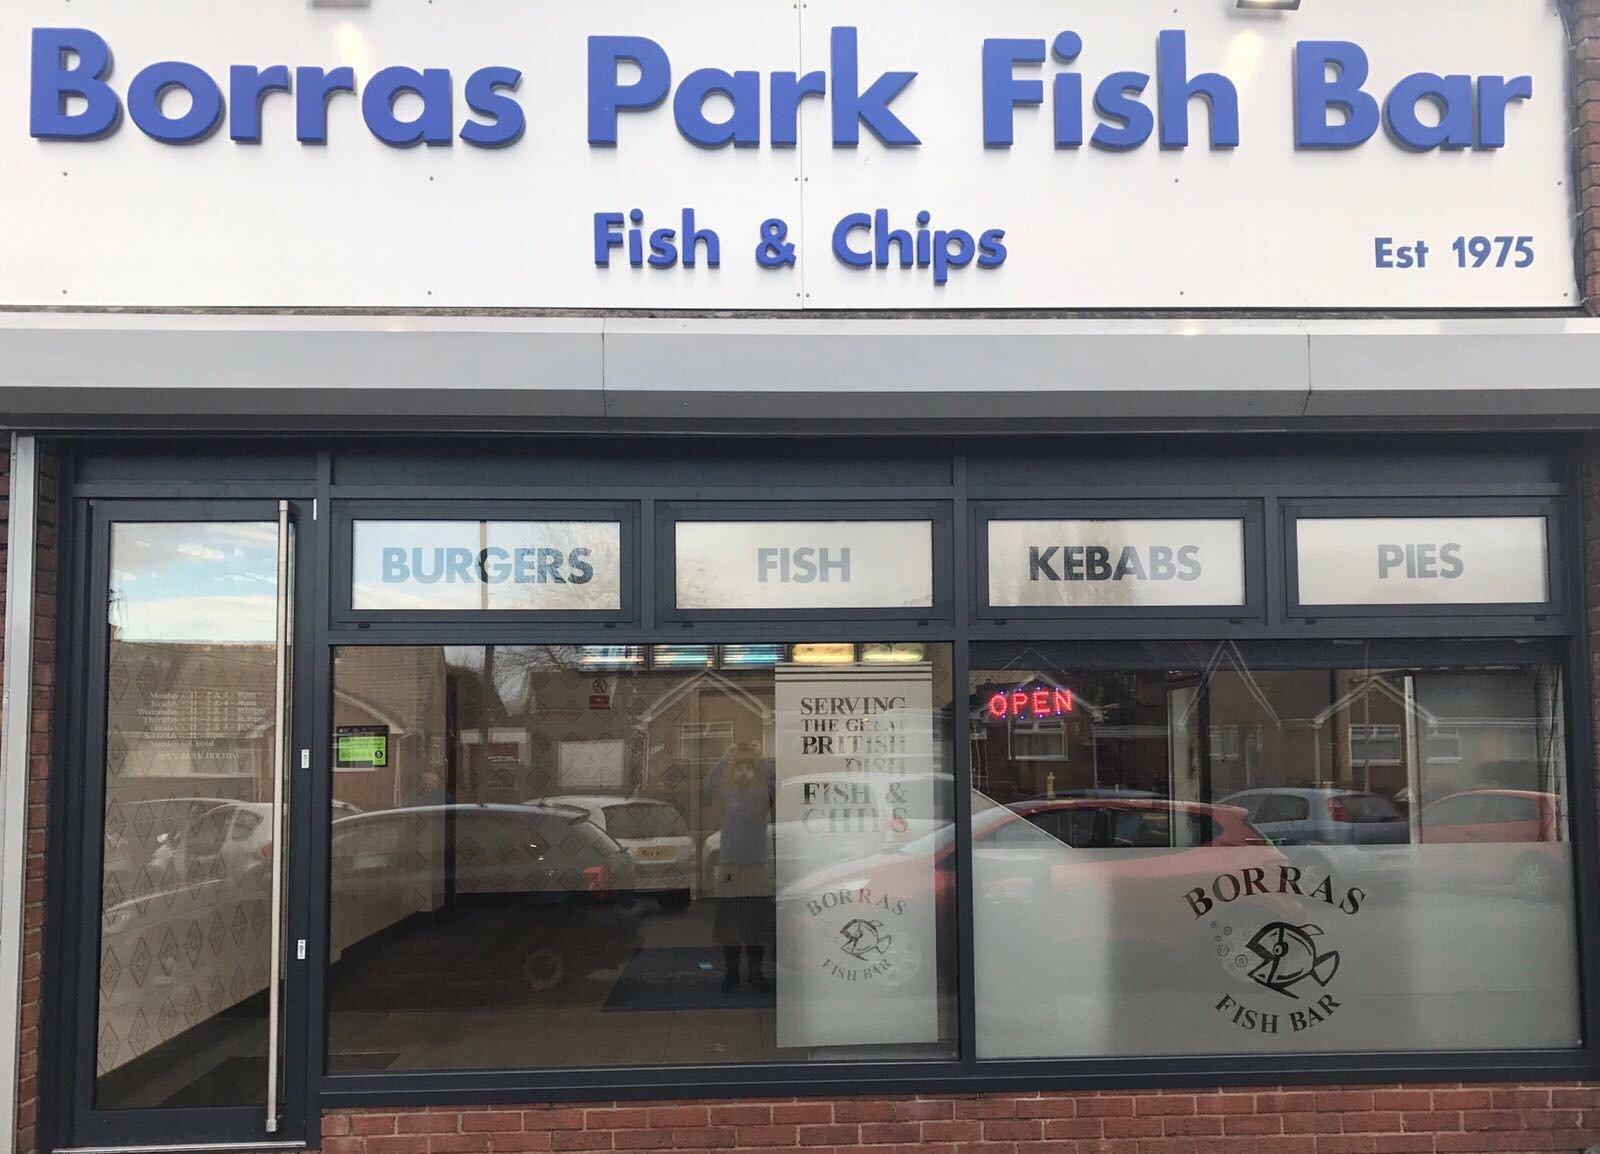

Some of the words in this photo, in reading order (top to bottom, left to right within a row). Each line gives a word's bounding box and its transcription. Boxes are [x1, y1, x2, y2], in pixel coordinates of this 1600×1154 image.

[30, 27, 525, 147] Borras
[587, 26, 922, 149] Park
[983, 29, 1240, 150] Fish
[1293, 40, 1532, 151] Bar
[594, 208, 721, 269] Fish
[755, 218, 796, 269] &
[831, 208, 1007, 284] Chips
[1374, 238, 1428, 268] Est
[1452, 236, 1535, 269] 1975
[382, 546, 594, 585] BURGERS
[757, 547, 851, 583] FISH
[1028, 545, 1202, 582] KEBABS
[1378, 543, 1465, 580] PIES
[800, 696, 908, 716] SERVING
[988, 688, 1073, 716] OPEN
[800, 718, 839, 732] THE
[800, 735, 906, 755] BRITISH
[845, 757, 906, 777] DISH
[803, 782, 872, 805] FISH
[885, 782, 908, 804] &
[805, 887, 907, 917] BORRAS
[1182, 865, 1366, 921] BORRAS
[822, 957, 857, 981] FISH
[863, 957, 892, 981] BAR
[1214, 993, 1279, 1034] FISH
[1288, 993, 1342, 1033] BAR
